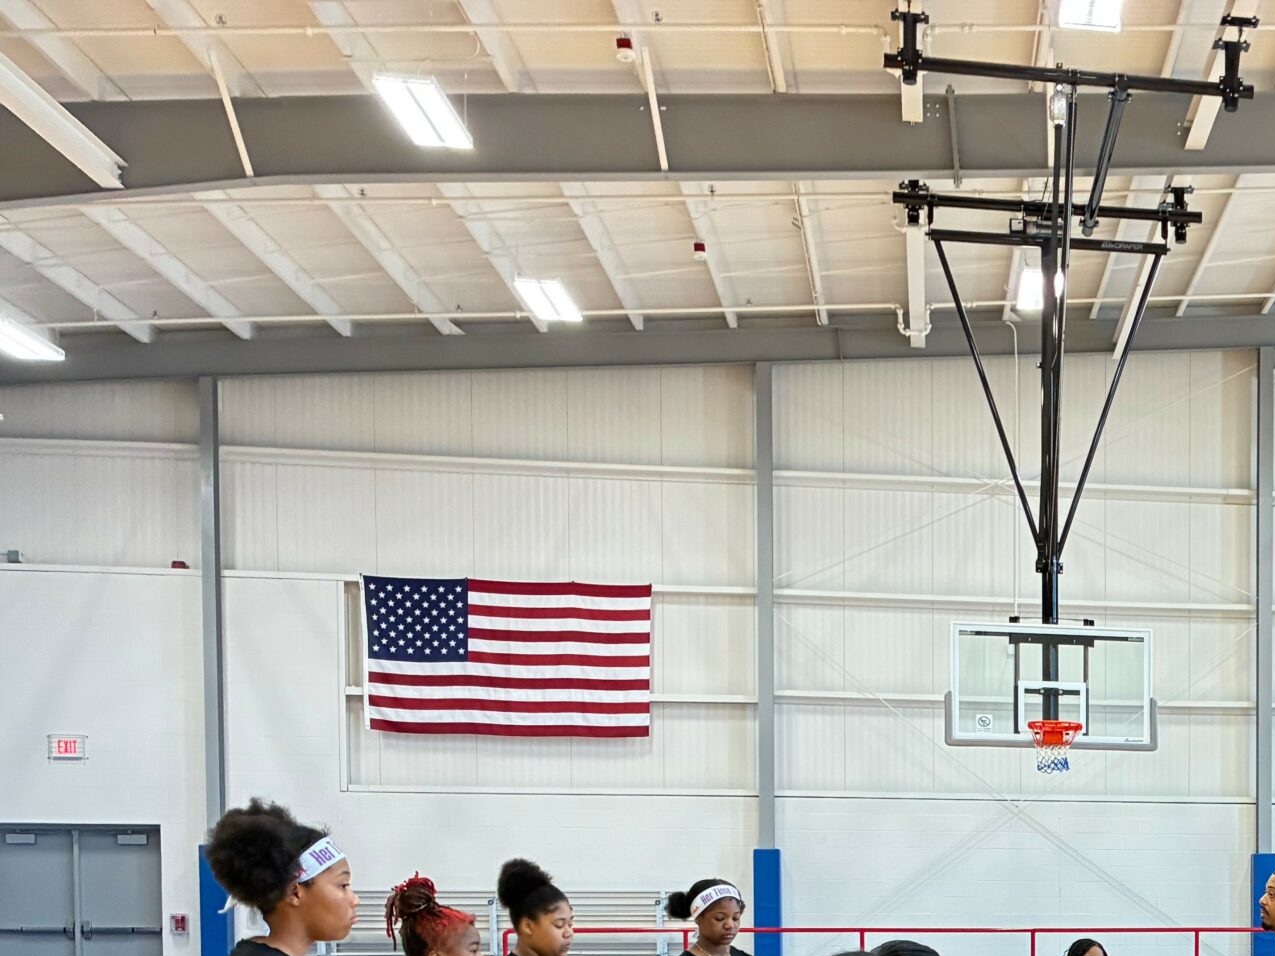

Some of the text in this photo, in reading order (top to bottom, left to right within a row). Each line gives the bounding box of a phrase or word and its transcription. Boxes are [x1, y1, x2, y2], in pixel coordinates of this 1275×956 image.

[57, 739, 78, 754] EXIT
[308, 846, 336, 867] Her
[700, 892, 714, 905] Her
